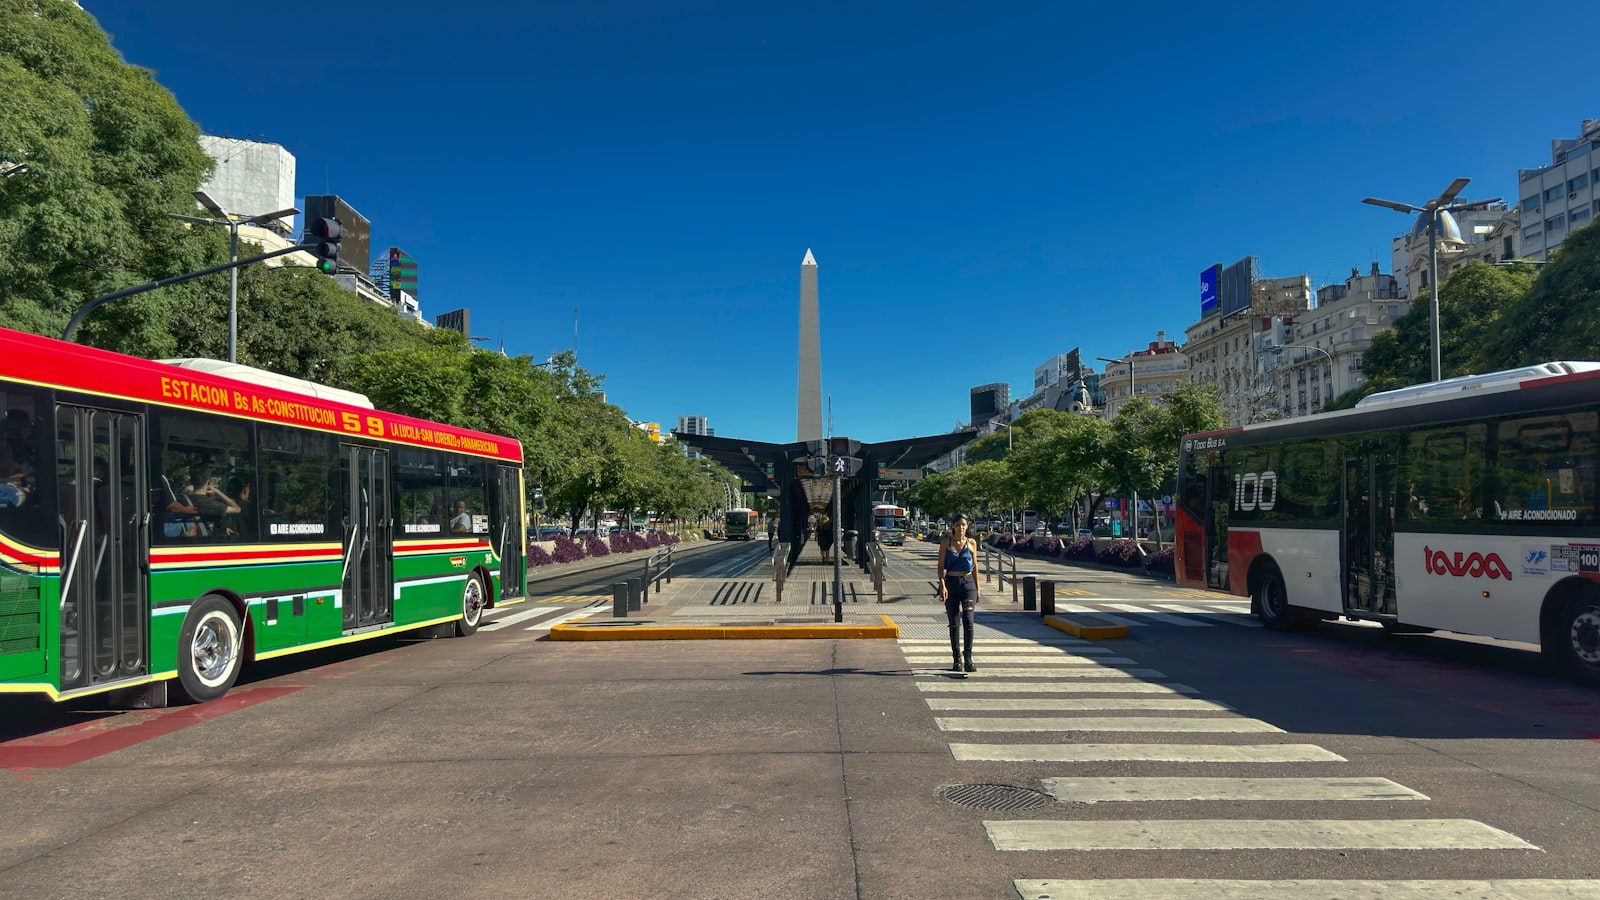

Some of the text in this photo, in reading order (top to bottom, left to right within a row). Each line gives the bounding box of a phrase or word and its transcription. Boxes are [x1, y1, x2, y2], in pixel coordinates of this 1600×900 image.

[161, 376, 229, 407] ESTACION
[341, 411, 384, 436] 59
[1234, 470, 1277, 511] 100
[1508, 509, 1577, 520] AIRE ACONDICIONADO
[1580, 553, 1598, 566] 100
